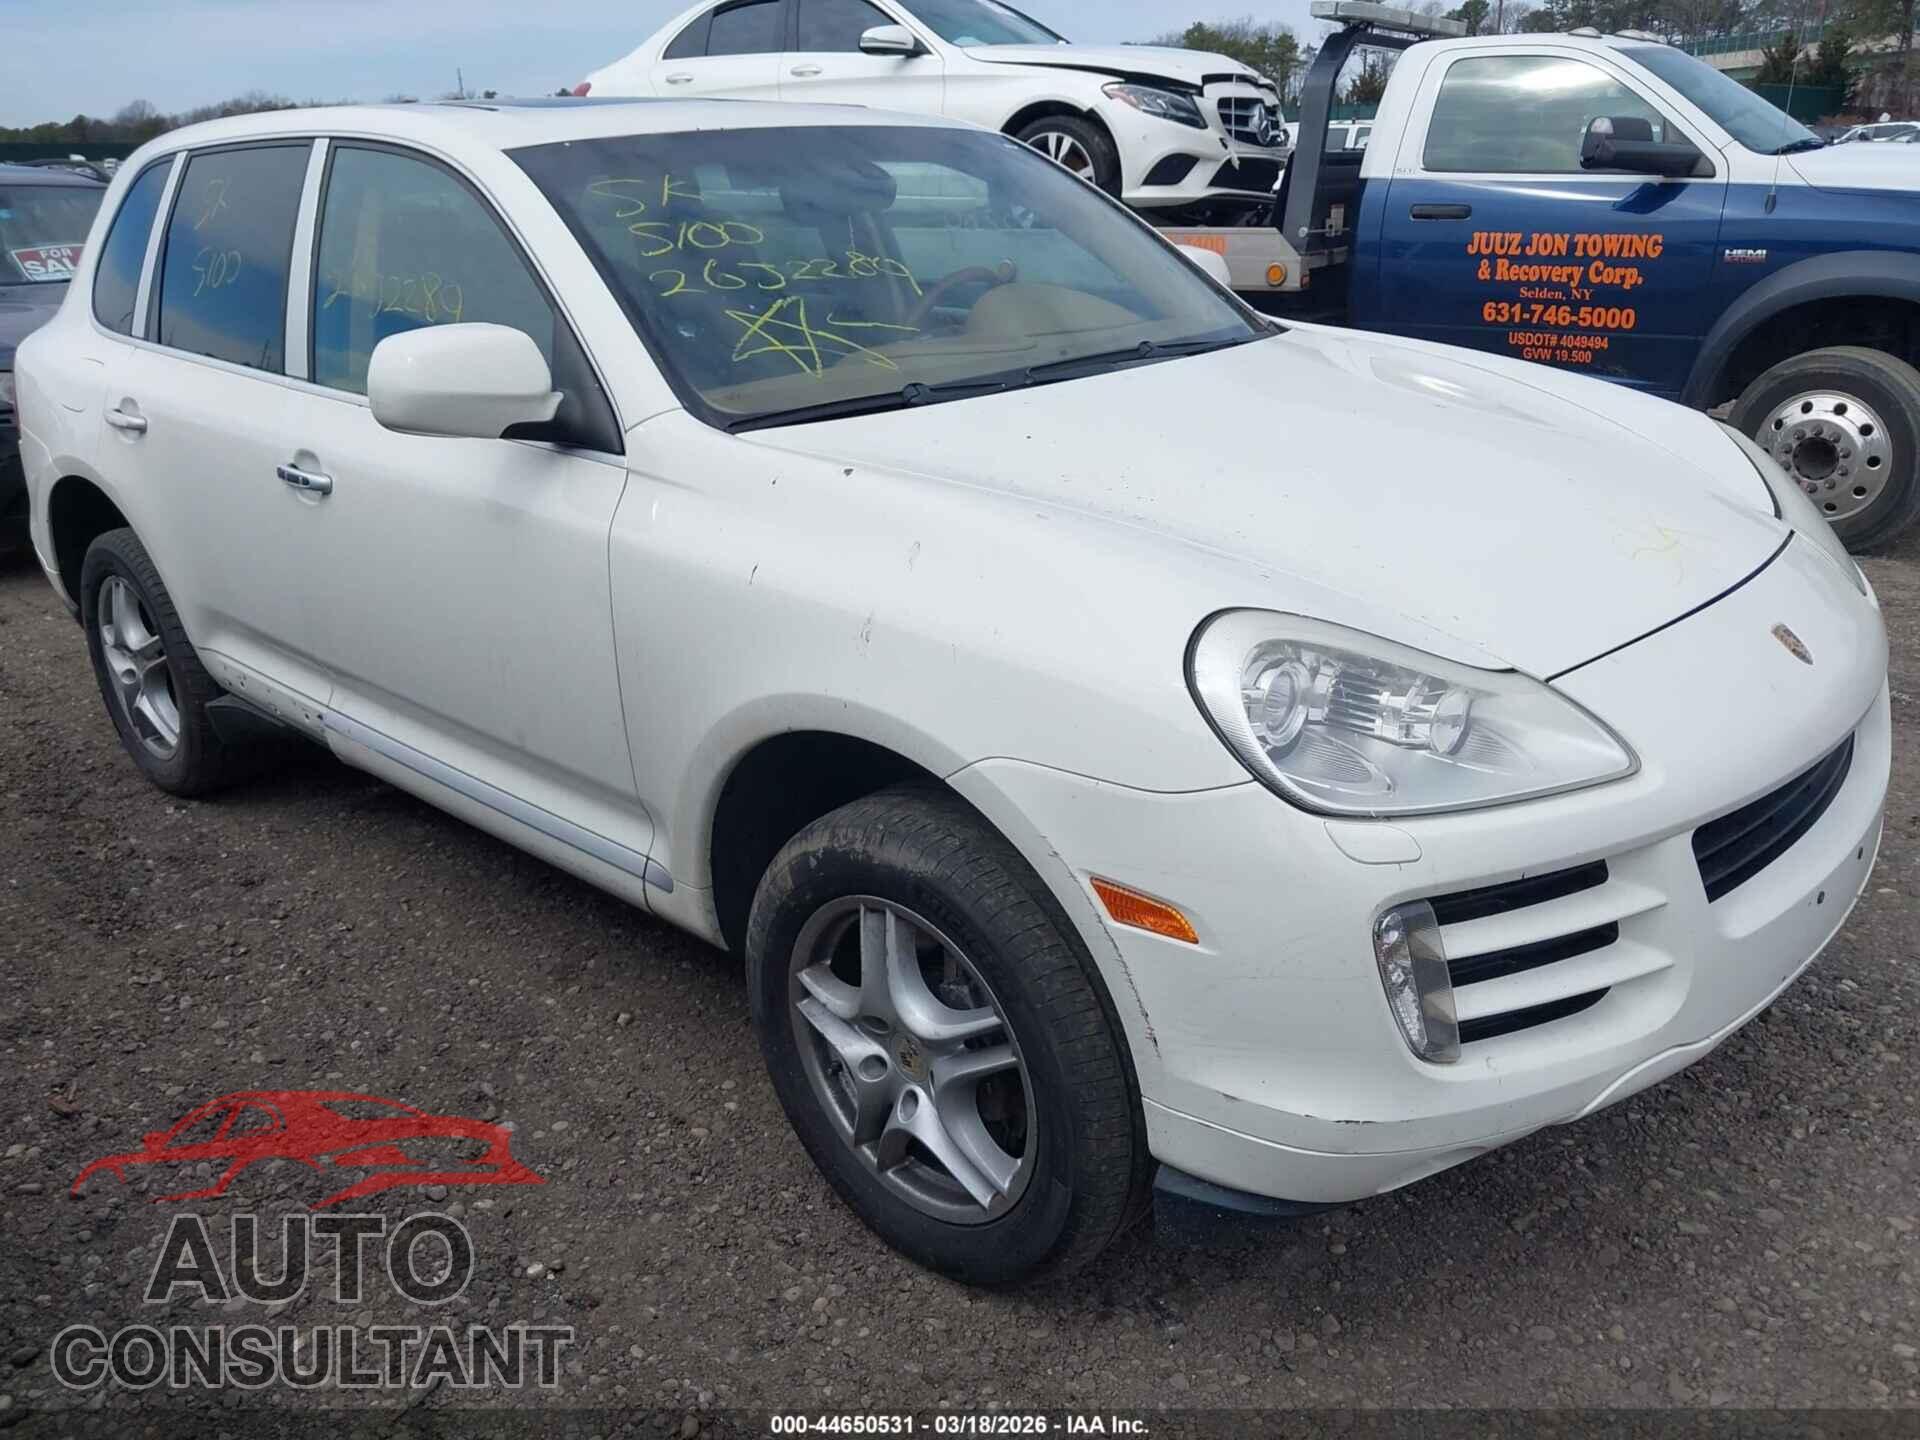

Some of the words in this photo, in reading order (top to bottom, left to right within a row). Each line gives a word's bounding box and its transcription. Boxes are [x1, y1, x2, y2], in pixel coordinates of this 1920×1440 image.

[1467, 231, 1523, 255] JUUZ
[1525, 233, 1570, 256] JON
[1574, 234, 1664, 258] TOWING
[1724, 249, 1767, 258] HEMI
[39, 248, 73, 260] FOR
[23, 256, 83, 274] SAL
[1477, 258, 1491, 280] &
[1495, 258, 1584, 287] Recovery
[1589, 261, 1644, 290] Corp.
[1519, 286, 1567, 301] Selden,
[1571, 288, 1594, 301] NY
[1482, 302, 1636, 329] 631-746-5000
[1508, 332, 1557, 346] USDOT#
[1560, 335, 1609, 350] 4049494
[1523, 348, 1552, 361] GVW
